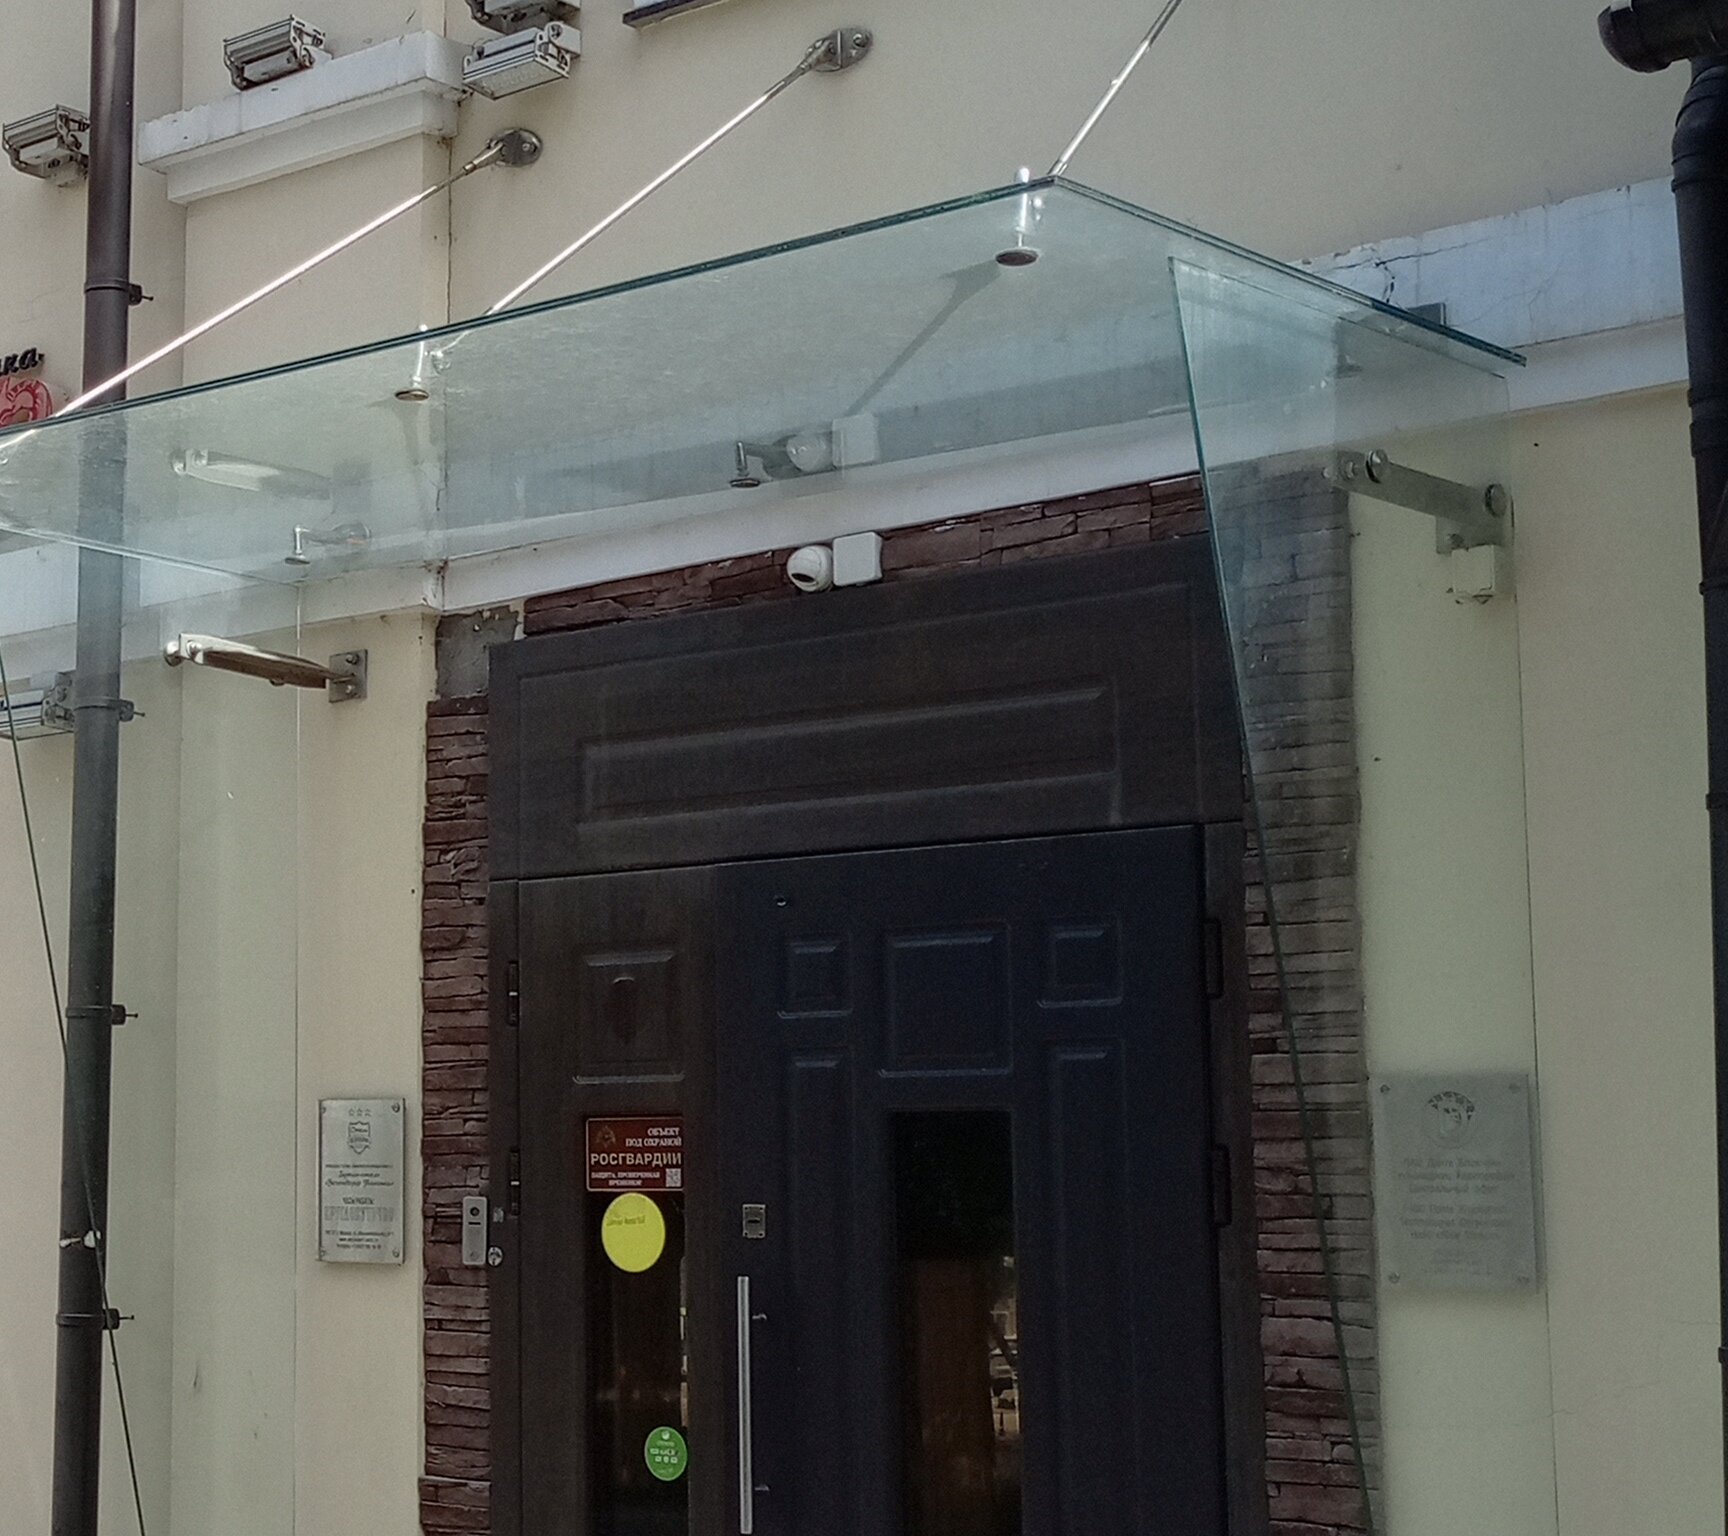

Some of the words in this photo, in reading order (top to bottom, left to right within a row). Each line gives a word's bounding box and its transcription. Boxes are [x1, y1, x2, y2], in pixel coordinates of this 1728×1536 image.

[647, 1127, 680, 1137] ОБЪЕКТ
[625, 1138, 643, 1148] ПОД
[643, 1137, 682, 1147] ОХРАНОЙ
[590, 1152, 682, 1167] РОСГВАРДИИ
